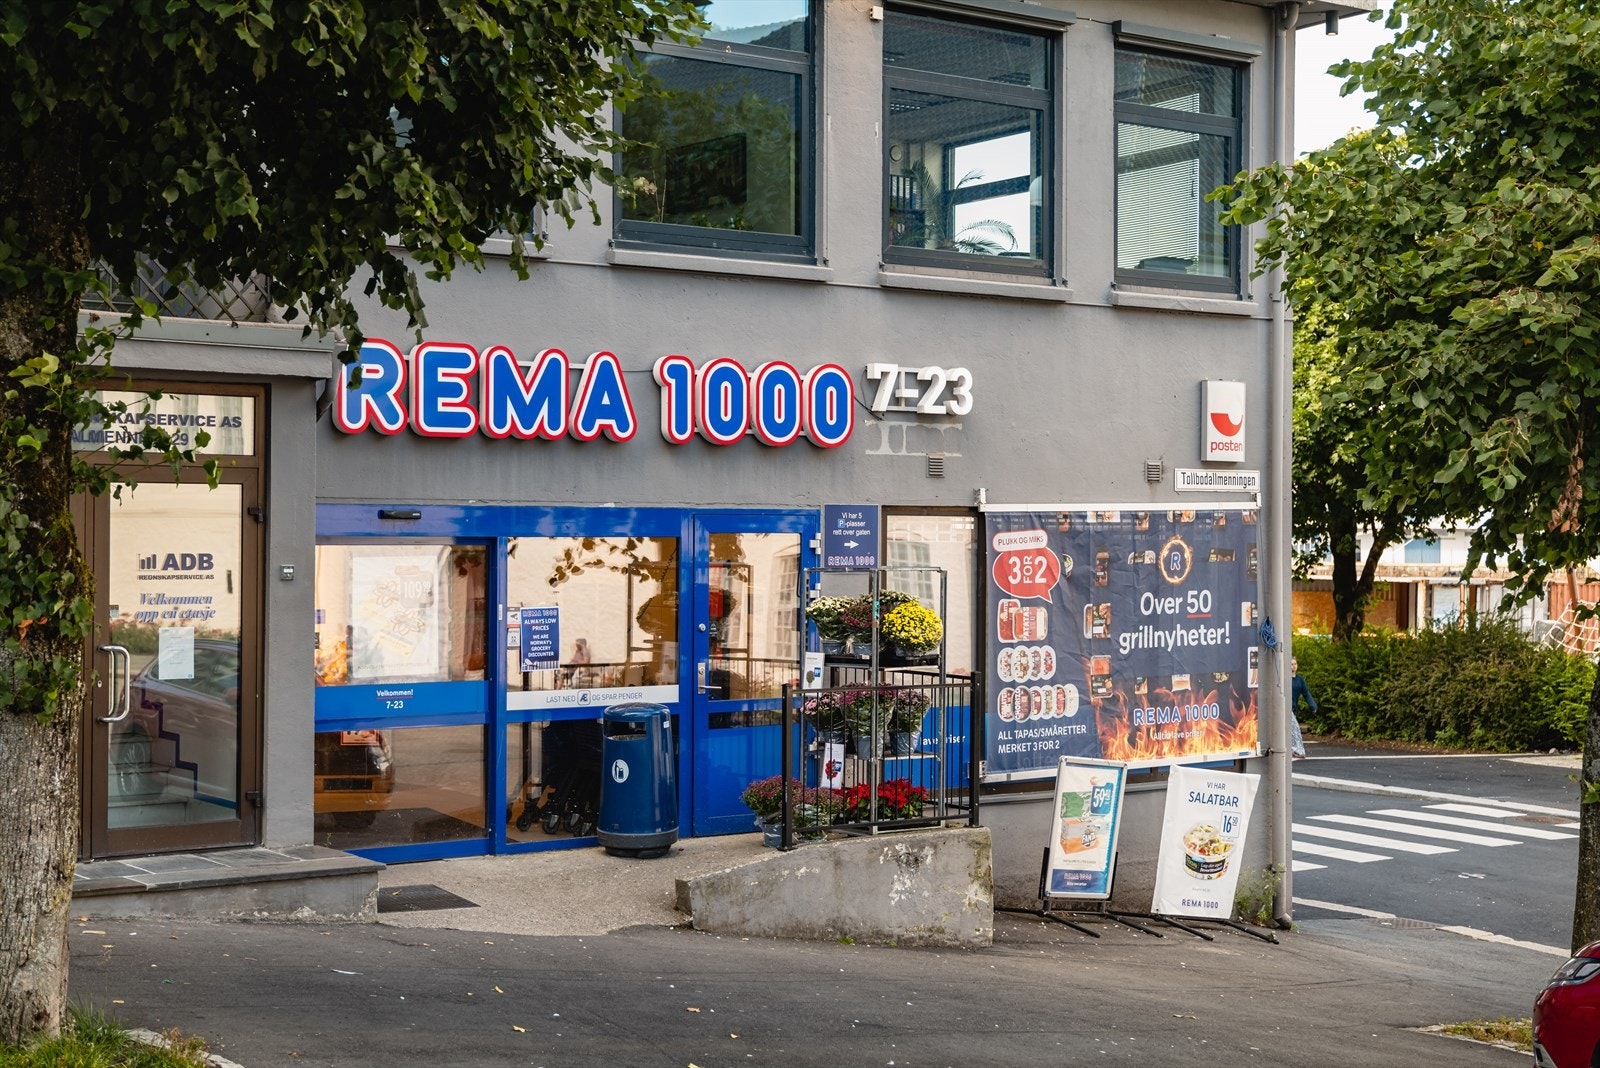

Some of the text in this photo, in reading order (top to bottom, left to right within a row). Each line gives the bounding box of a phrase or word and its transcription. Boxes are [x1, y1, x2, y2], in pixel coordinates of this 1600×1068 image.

[334, 338, 855, 448] REMA 1000
[867, 363, 973, 415] 7-23
[219, 416, 242, 428] AS
[172, 433, 189, 446] 29
[1210, 440, 1243, 453] posten
[1181, 472, 1256, 489] Tollbodallmenningen
[998, 537, 1018, 546] PLUKK
[1029, 536, 1044, 544] MIKS
[161, 553, 214, 570] ADB
[828, 556, 875, 566] REMA 1000
[1170, 552, 1181, 571] R
[1008, 555, 1048, 585] 3 FOR 2
[404, 582, 422, 599] 109
[140, 593, 213, 605] Velkommen
[1140, 589, 1212, 616] Over 50
[134, 607, 216, 623] opp en etasje
[1119, 621, 1231, 655] grillnyheter!
[376, 689, 414, 697] Velkommen!
[386, 701, 404, 709] 7-23
[1134, 703, 1220, 726] REMA 1000
[943, 734, 965, 744] riser
[998, 724, 1086, 740] ALL TAPAS/SMÅRETTER
[1172, 731, 1184, 739] lave
[998, 740, 1060, 754] MERKET 3 FOR 2
[1093, 788, 1105, 808] 59
[1188, 791, 1239, 808] SALATBAR
[1222, 815, 1232, 833] 16
[1182, 899, 1218, 909] REMA 1000
